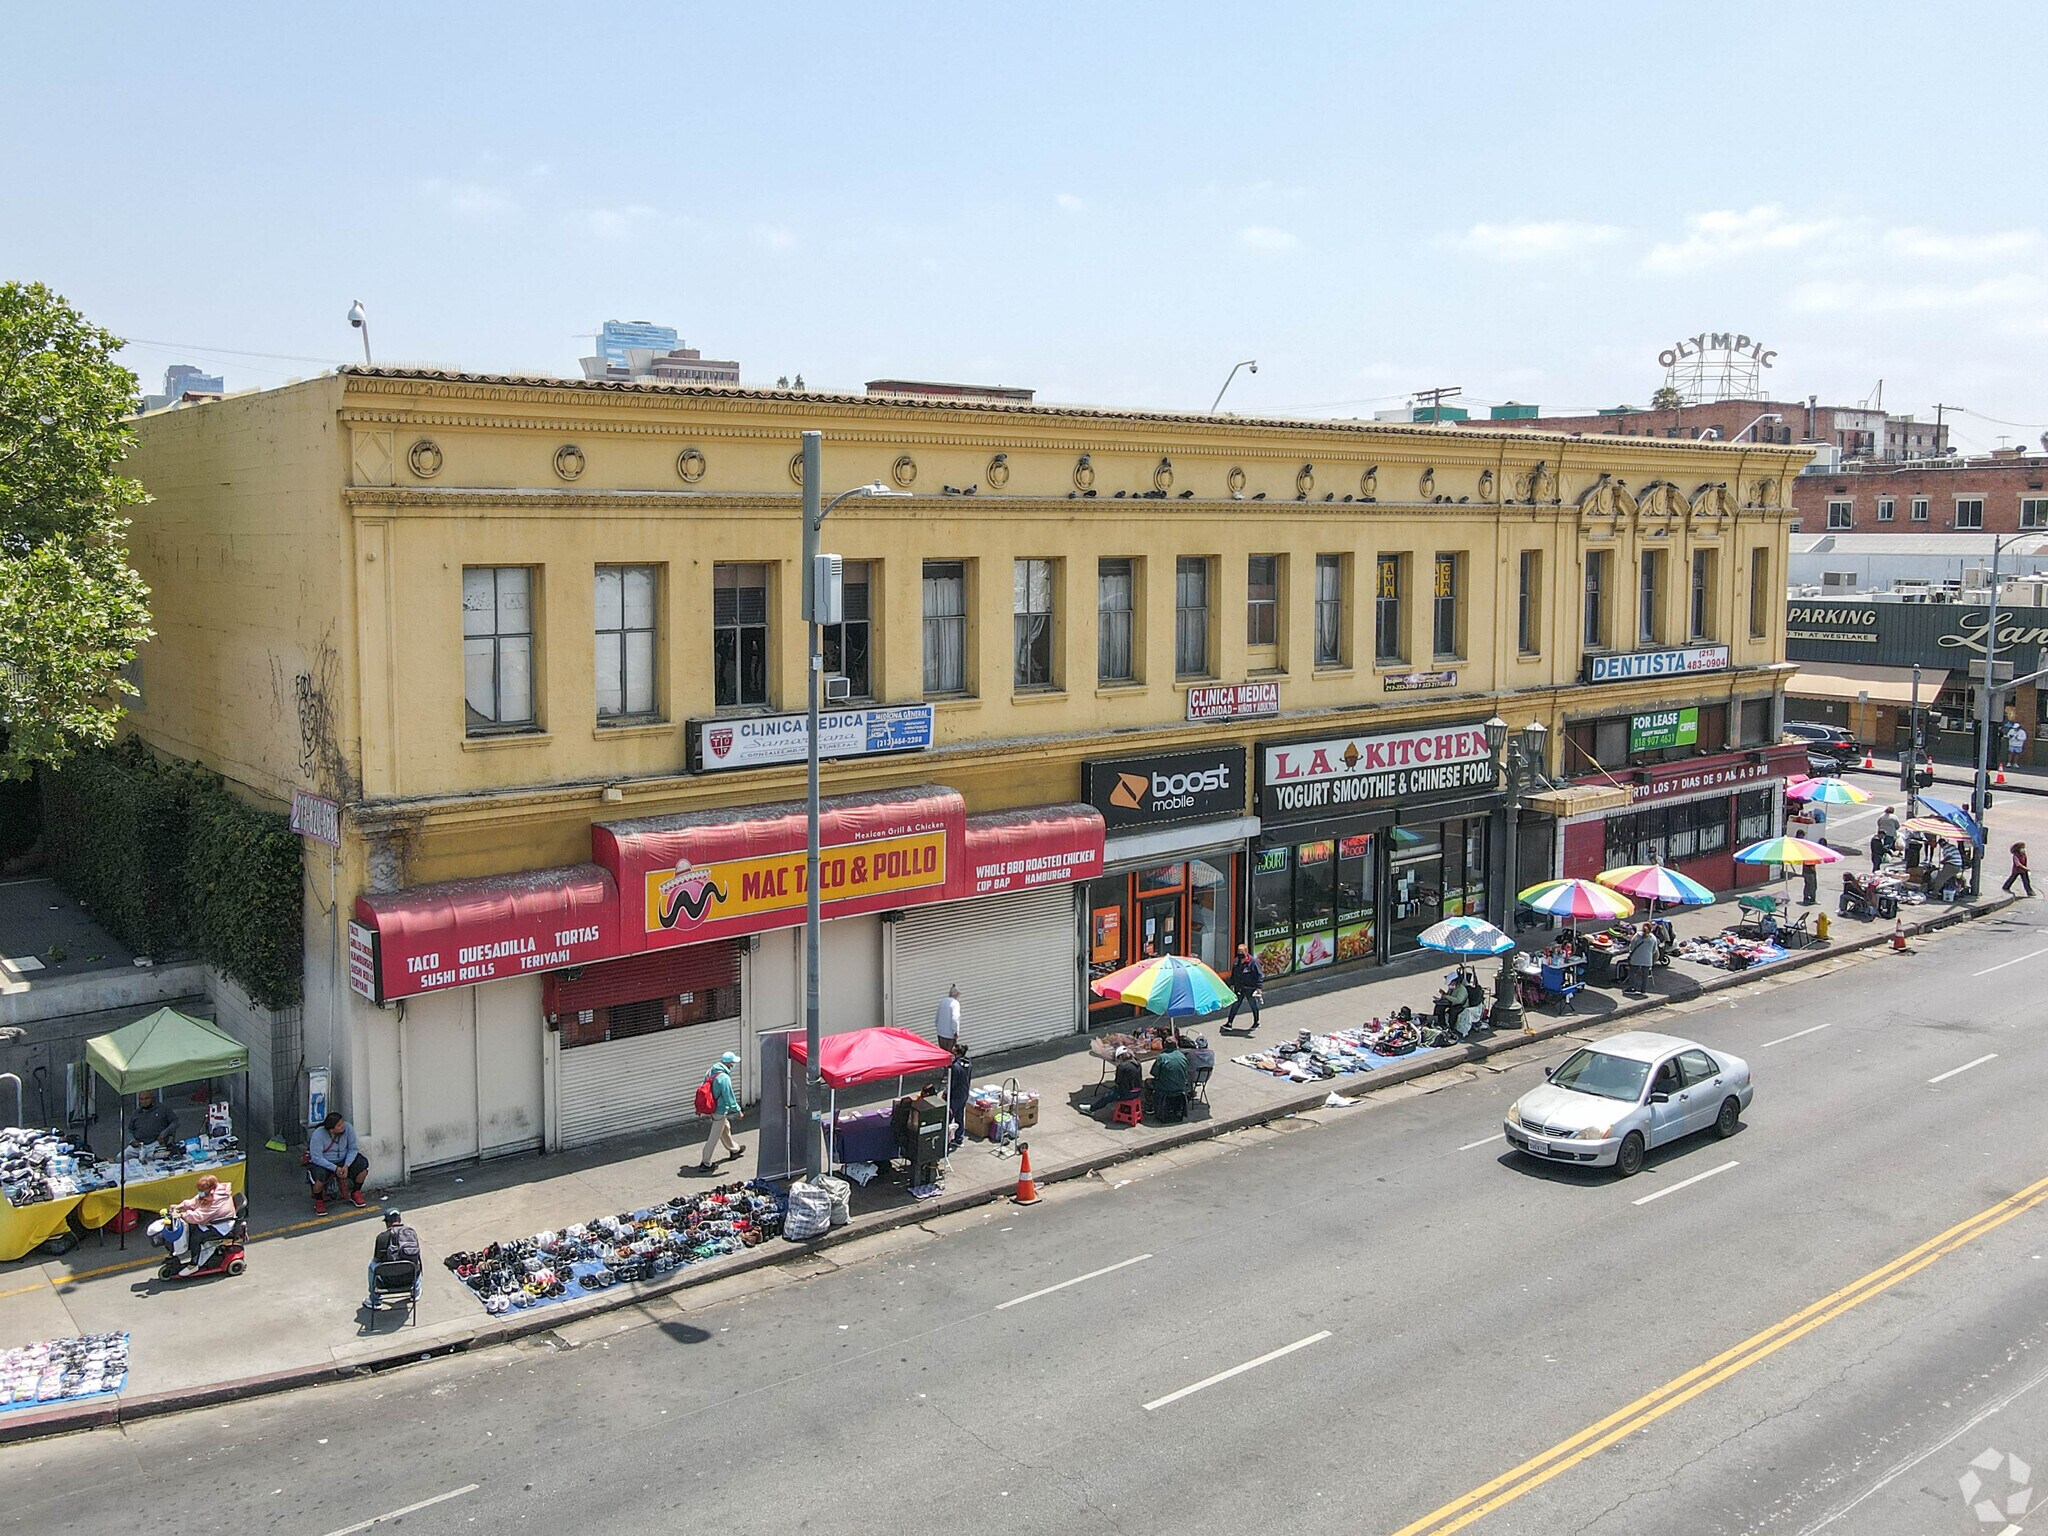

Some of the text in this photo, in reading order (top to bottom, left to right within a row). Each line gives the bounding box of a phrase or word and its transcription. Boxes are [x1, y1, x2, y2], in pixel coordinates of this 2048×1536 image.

[1658, 332, 1778, 368] OLYMPIC
[1787, 607, 1876, 625] PARKING
[1822, 633, 1869, 641] WESTLAKE
[1698, 649, 1716, 658] (213)
[1594, 653, 1726, 679] DENTISTA 483-0904
[1191, 684, 1277, 708] CLINICA MEDICA
[1190, 706, 1200, 717] LA
[1201, 704, 1232, 717] CARIDAD
[1633, 713, 1678, 730] FOR LEASE
[741, 720, 803, 737] CLINICA
[806, 714, 863, 732] EDICA
[1365, 731, 1489, 770] KITCHEN
[1152, 763, 1230, 798] boost
[1276, 782, 1330, 810] YOGURT
[1333, 774, 1396, 804] SMOOTHIE
[1398, 772, 1407, 794] &
[1411, 764, 1460, 793] CHINESE
[1653, 782, 1669, 794] LOS
[1672, 780, 1678, 790] 7
[1681, 776, 1700, 789] DIAS
[1703, 774, 1714, 785] DE
[1716, 773, 1722, 783] 9
[1740, 768, 1746, 779] A
[1749, 766, 1754, 777] 9
[1757, 764, 1768, 776] PM
[1152, 795, 1195, 812] mobile
[854, 831, 886, 840] Mexican
[888, 827, 905, 836] Grill
[915, 822, 944, 832] Chicken
[1345, 846, 1365, 857] FOOD
[742, 845, 937, 902] MAC TCO & POLLO
[976, 862, 1005, 879] WHOLE
[1025, 854, 1062, 872] ROASTED
[1063, 849, 1096, 866] CHICKEN
[994, 877, 1010, 889] BAP
[1025, 868, 1071, 884] HAMBURGER
[1302, 918, 1329, 929] YOGURT
[1361, 908, 1374, 917] FOOD
[1254, 925, 1289, 939] TERIYAKI
[407, 925, 599, 973] TACO QUESADILLA TORTAS
[420, 949, 570, 988] SUSHI ROLLS TERIYAKI
